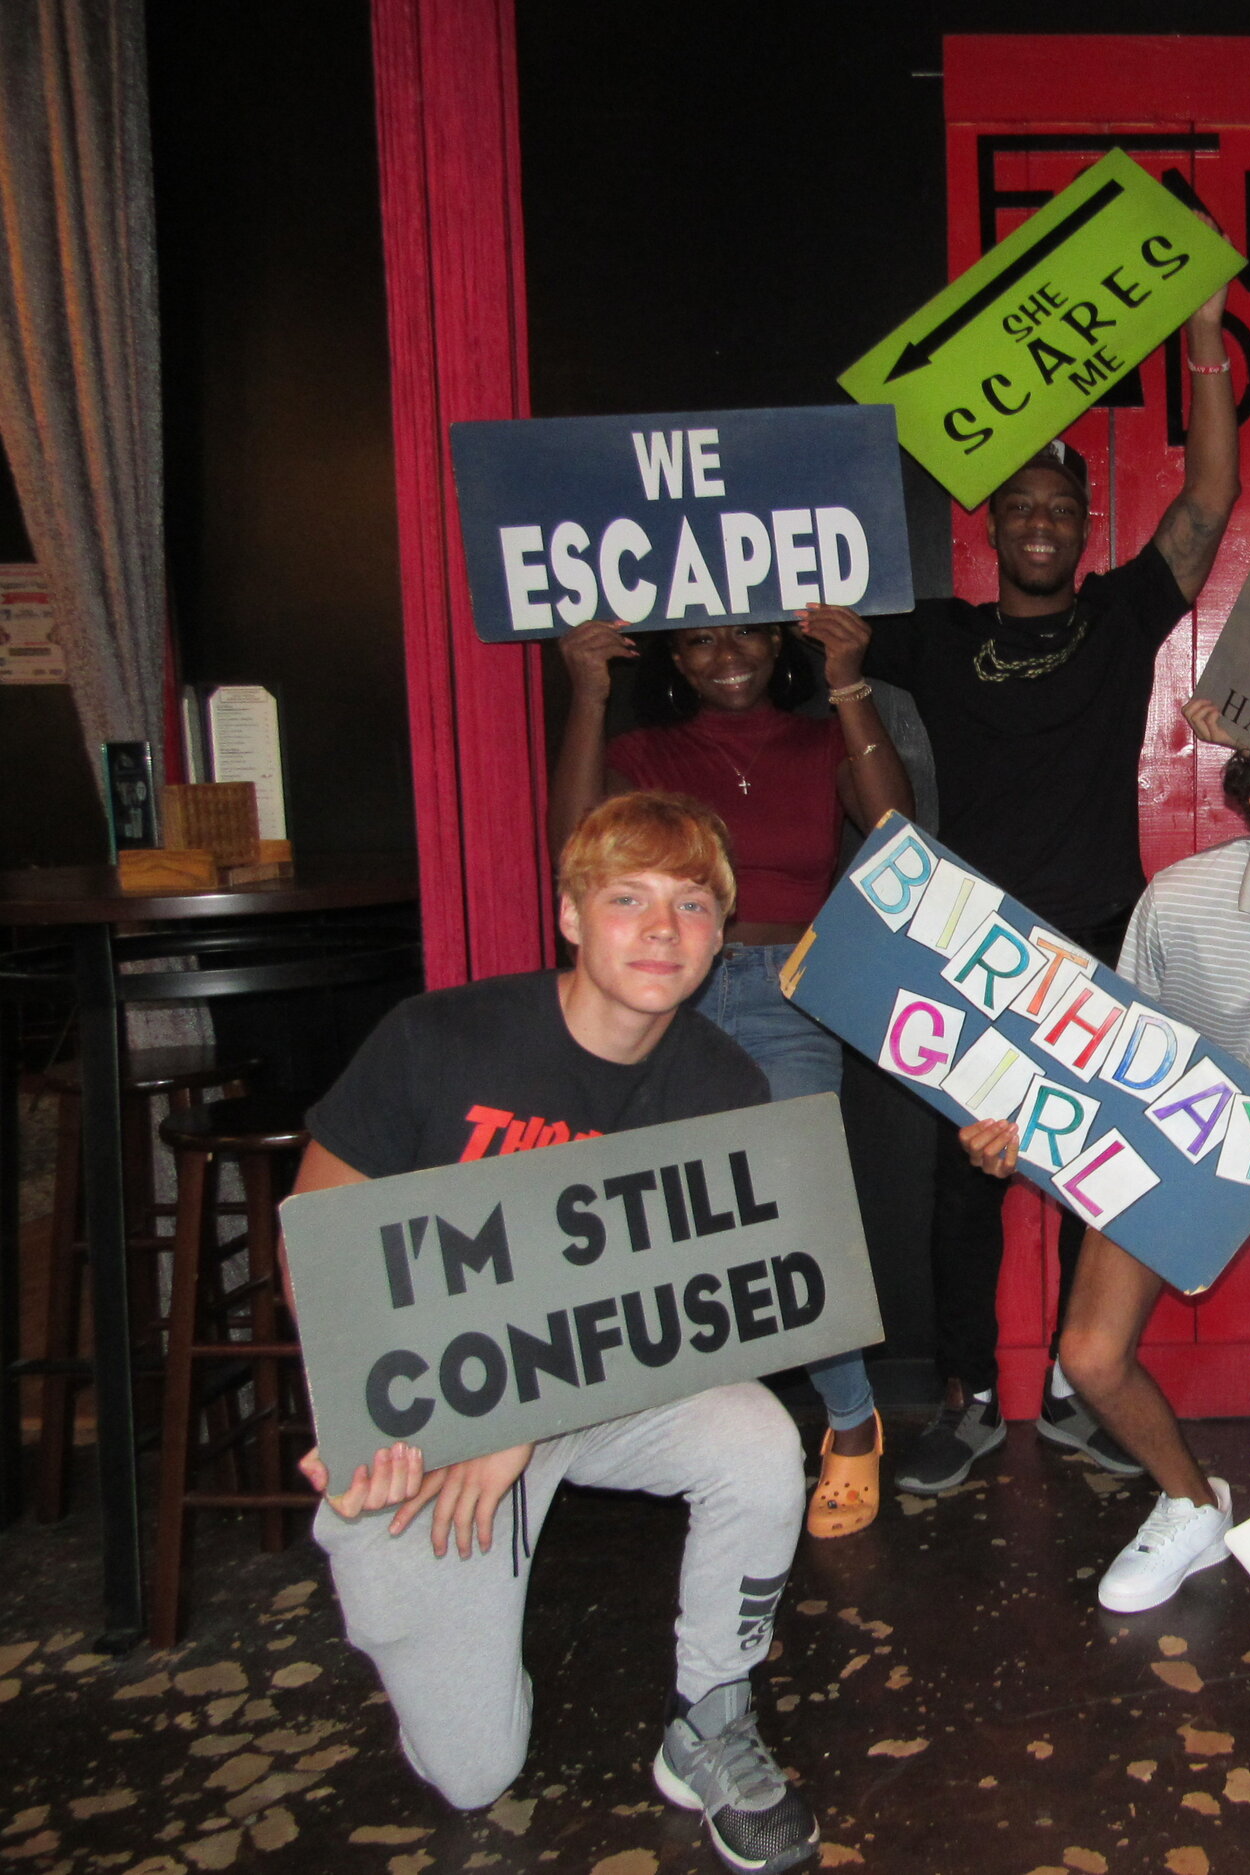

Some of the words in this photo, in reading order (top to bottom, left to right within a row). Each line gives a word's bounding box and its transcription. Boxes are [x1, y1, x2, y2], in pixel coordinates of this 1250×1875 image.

[944, 236, 1190, 454] SCARES
[1002, 282, 1069, 343] SHE
[1068, 345, 1125, 396] ME
[632, 428, 726, 500] WE
[500, 506, 870, 631] ESCAPED
[889, 1001, 1127, 1218] GIRL
[380, 1202, 514, 1310] I'M
[556, 1150, 778, 1266] STILL
[365, 1250, 826, 1438] CONFUSED
